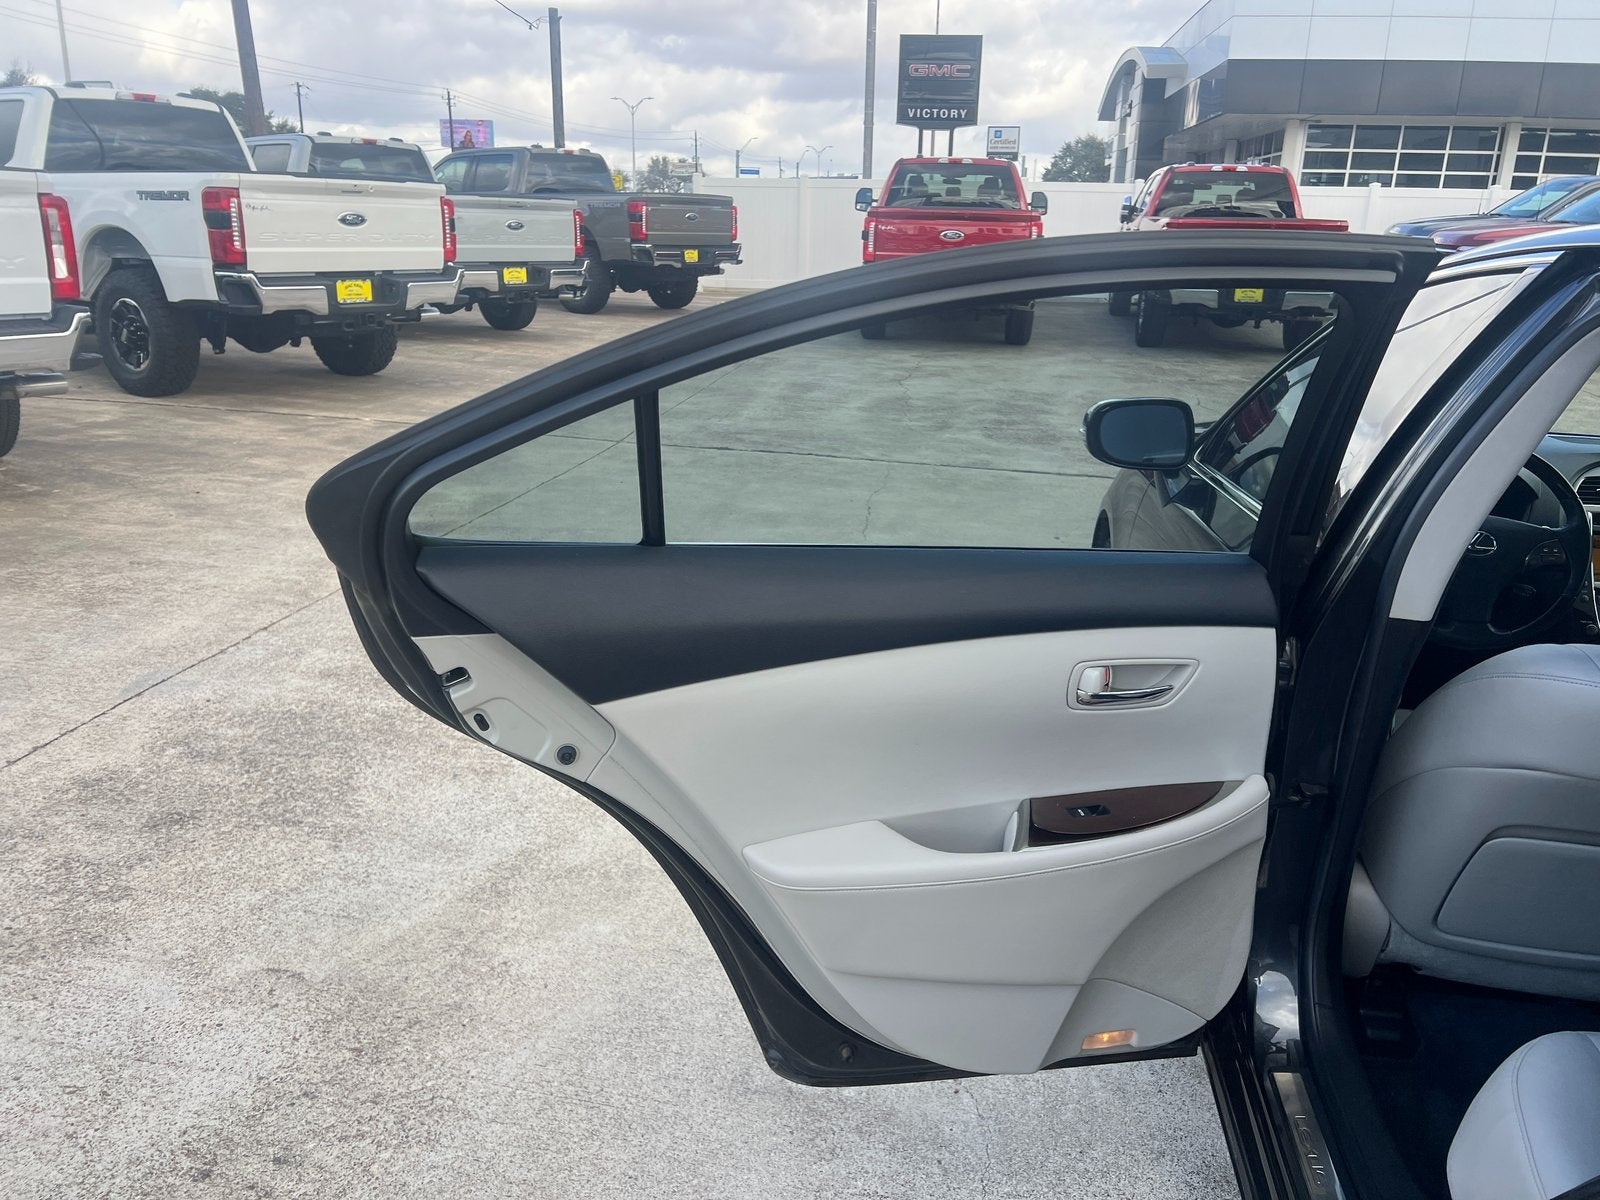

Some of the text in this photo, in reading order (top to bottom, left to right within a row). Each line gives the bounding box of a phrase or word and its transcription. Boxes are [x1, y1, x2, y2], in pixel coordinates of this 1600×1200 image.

[909, 63, 972, 77] GMC
[907, 108, 968, 119] VICTORY
[990, 138, 1017, 146] Certified
[136, 190, 190, 201] TREMOR
[258, 232, 435, 243] SUPER DUTY
